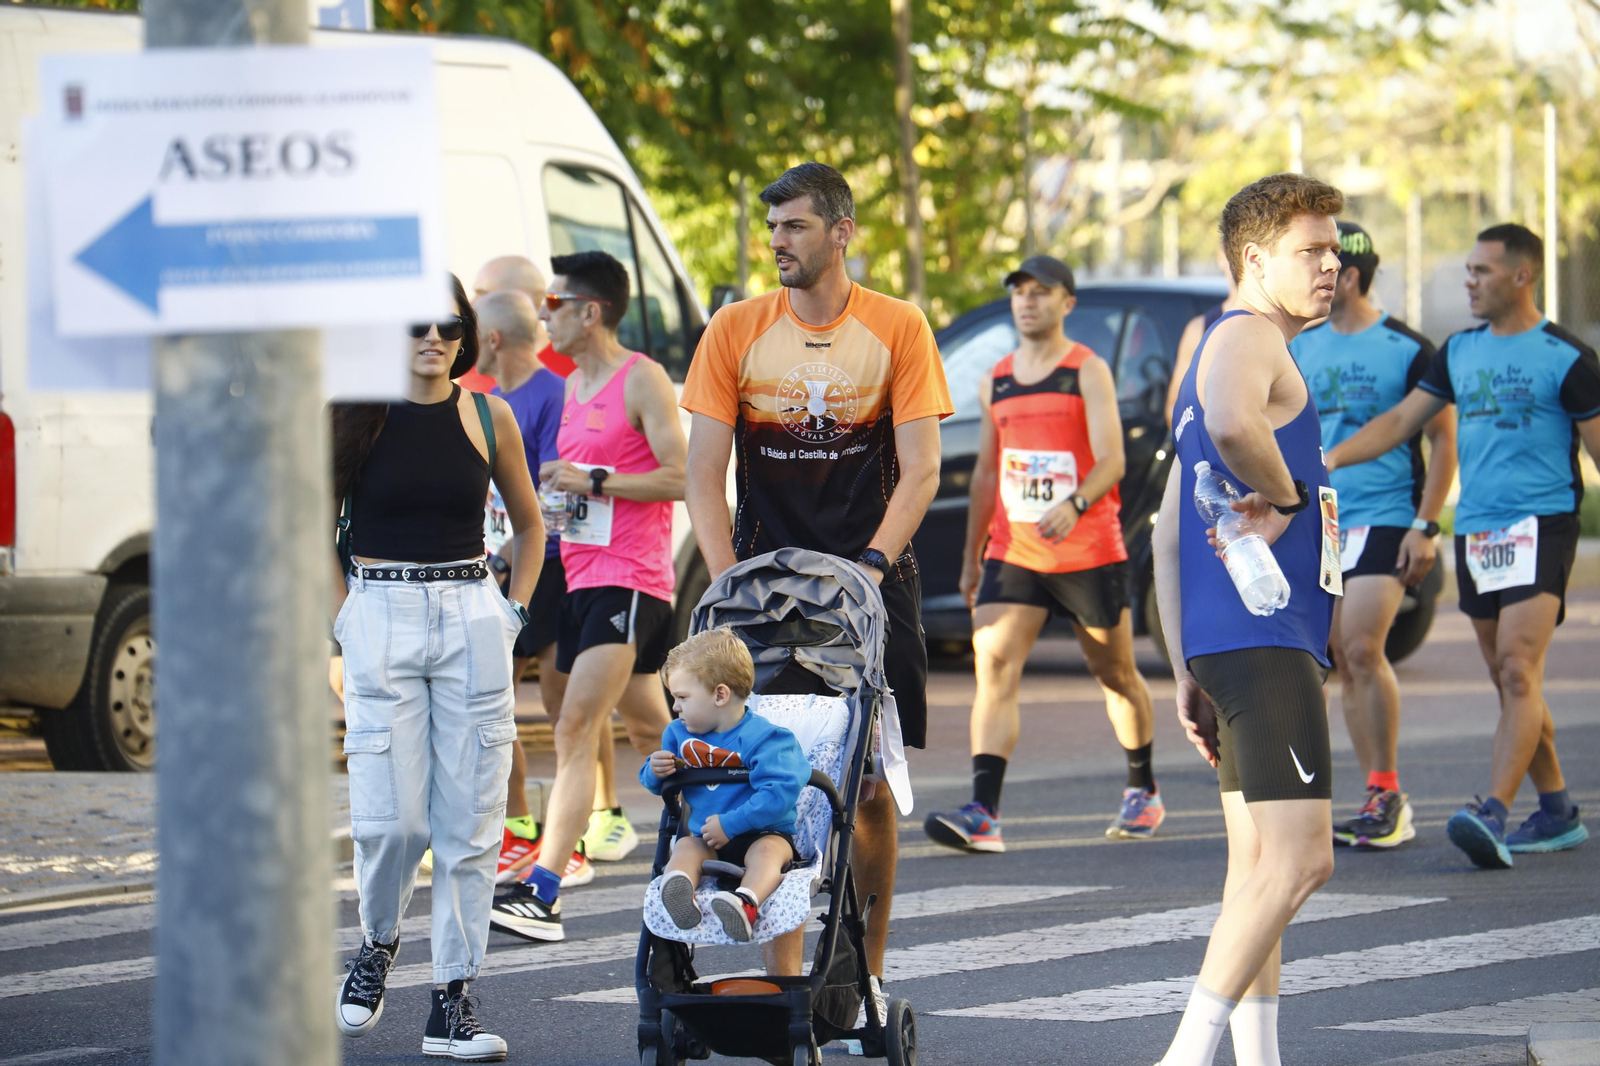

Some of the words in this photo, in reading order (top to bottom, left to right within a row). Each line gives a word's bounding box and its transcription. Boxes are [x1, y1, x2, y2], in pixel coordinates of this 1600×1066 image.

[160, 130, 357, 181] ASEOS
[781, 371, 800, 393] CLUB
[805, 366, 852, 393] ATLETISMO
[767, 447, 787, 460] Subida
[789, 450, 796, 459] al
[798, 449, 827, 459] Castillo
[829, 450, 839, 460] de
[1023, 478, 1053, 501] 143
[1481, 542, 1516, 570] 306
